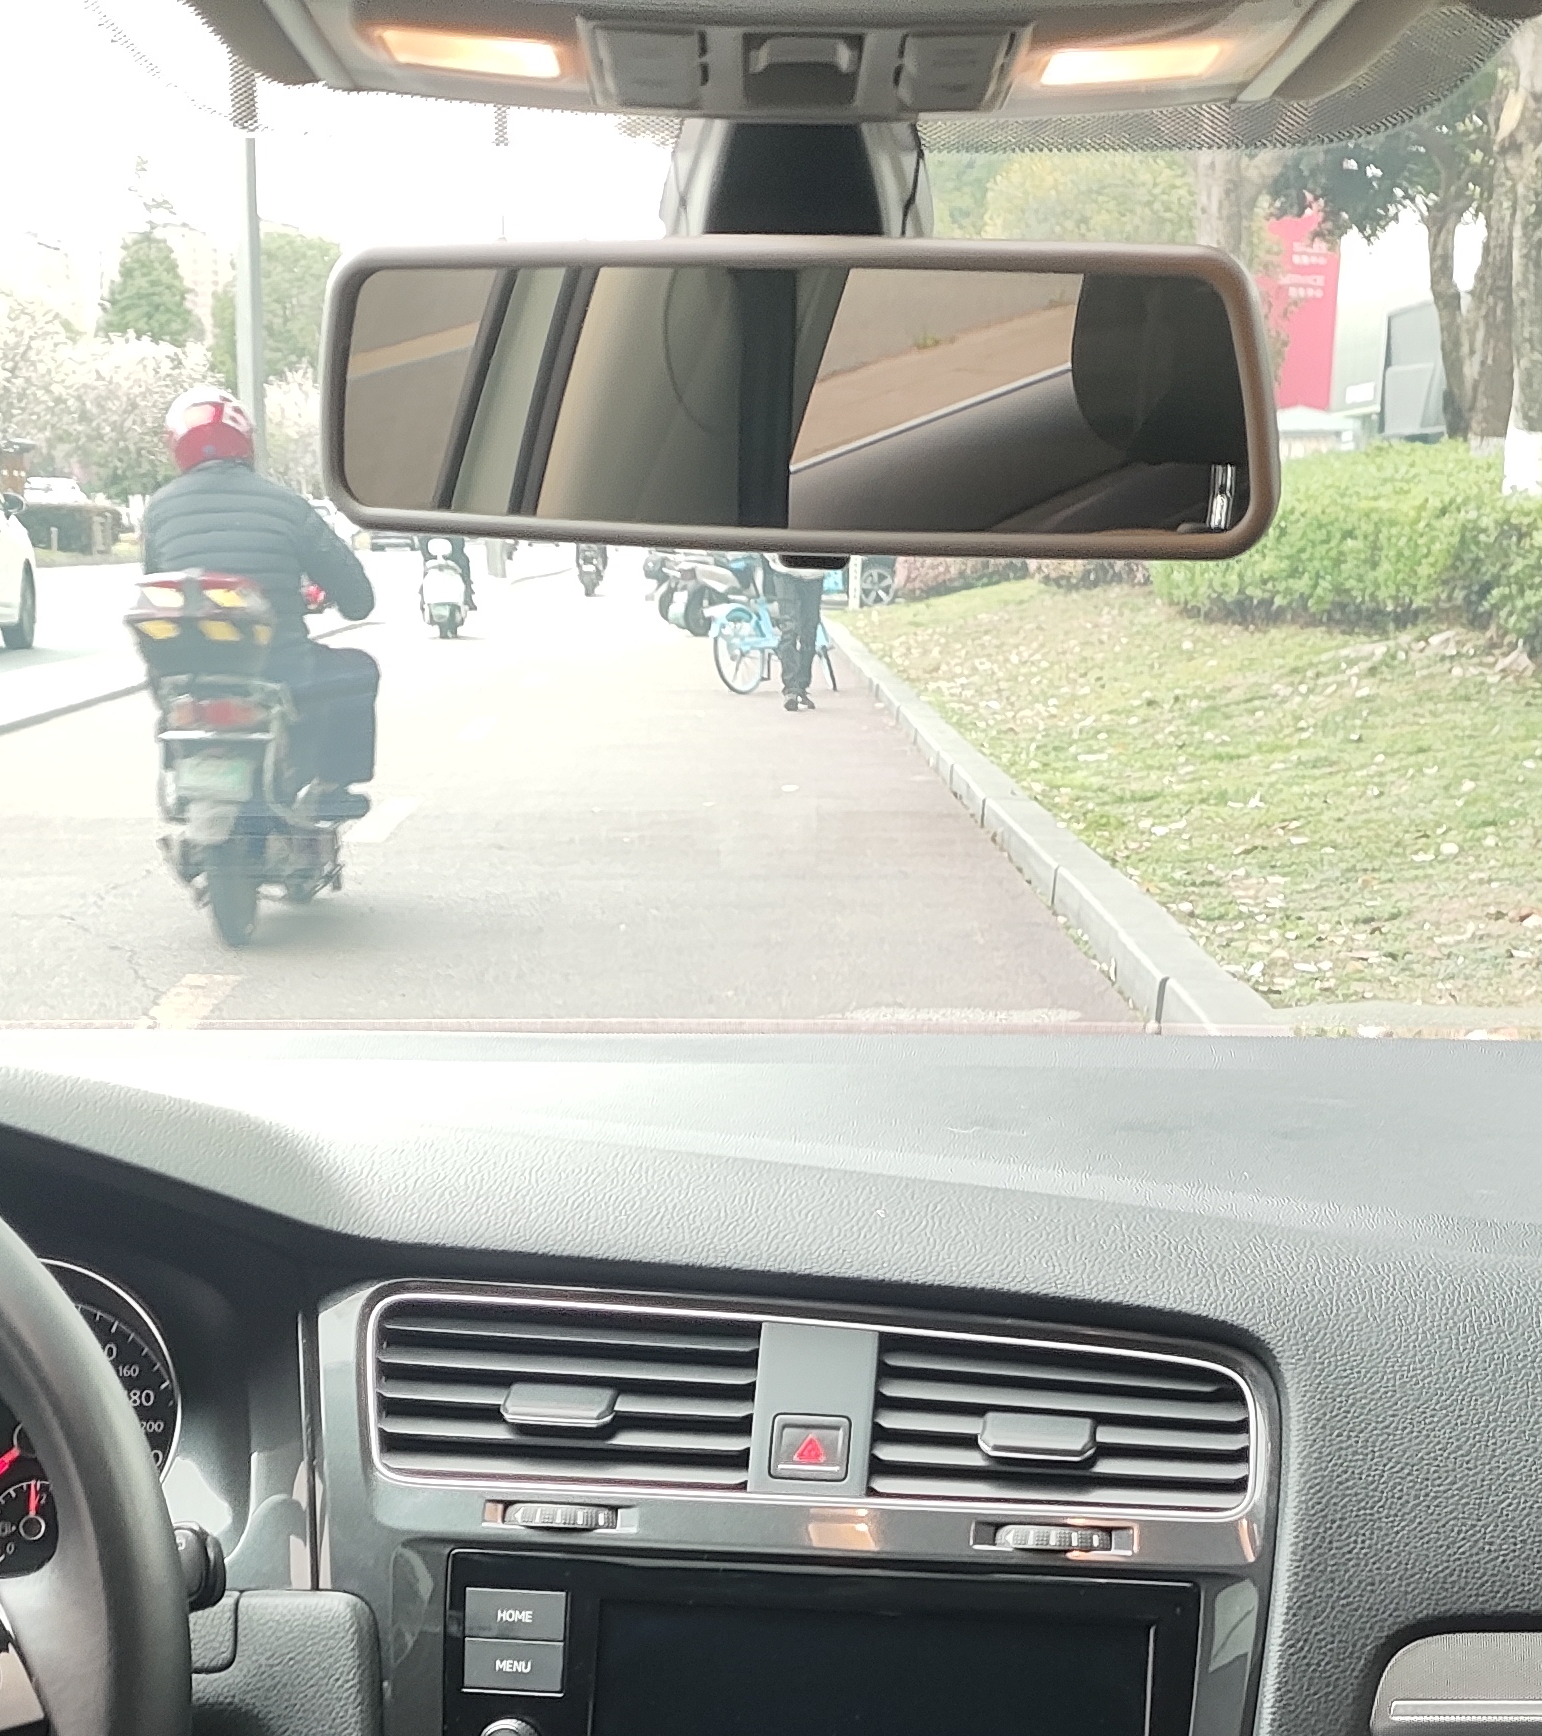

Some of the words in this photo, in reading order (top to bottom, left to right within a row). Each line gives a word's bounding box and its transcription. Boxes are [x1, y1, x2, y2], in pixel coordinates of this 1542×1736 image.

[119, 1365, 140, 1377] 160
[129, 1390, 154, 1406] 80
[6, 1542, 15, 1554] 0
[497, 1608, 533, 1623] HOME
[495, 1659, 531, 1673] MENU
